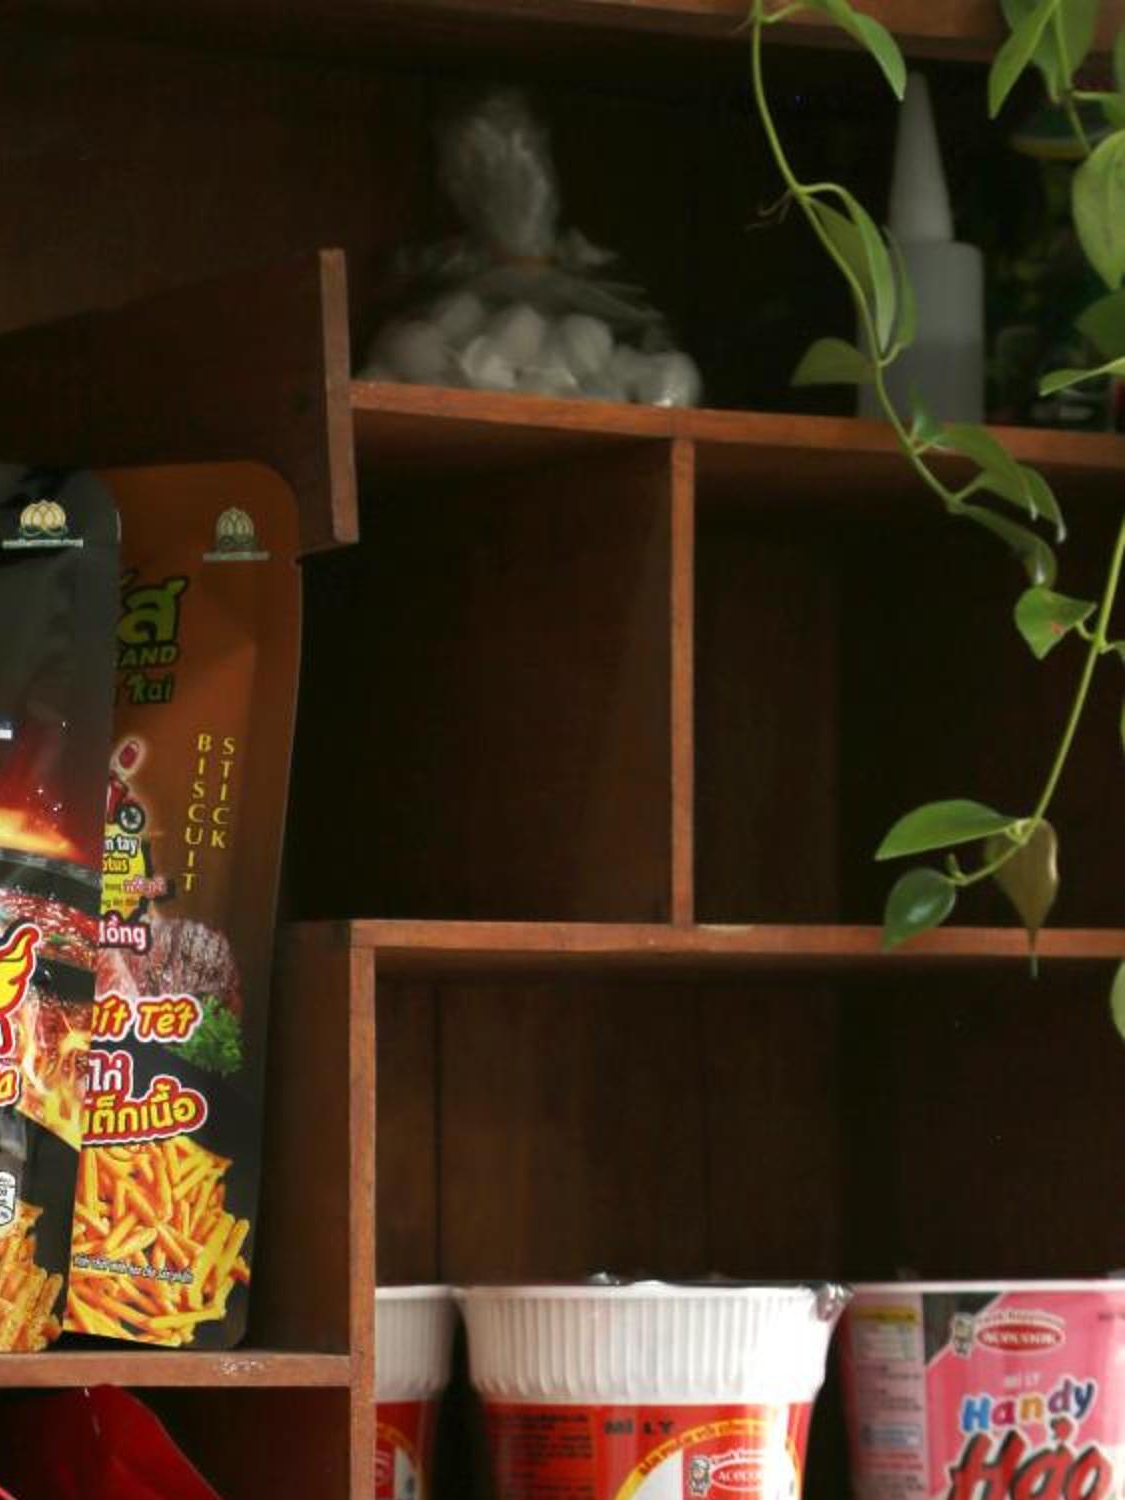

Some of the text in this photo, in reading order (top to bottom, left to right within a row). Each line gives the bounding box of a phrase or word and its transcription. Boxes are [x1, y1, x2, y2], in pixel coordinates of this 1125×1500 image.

[183, 734, 212, 891] BISCUIT
[211, 737, 236, 848] STICK
[140, 1001, 195, 1036] Tết
[962, 1379, 1095, 1432] Handy
